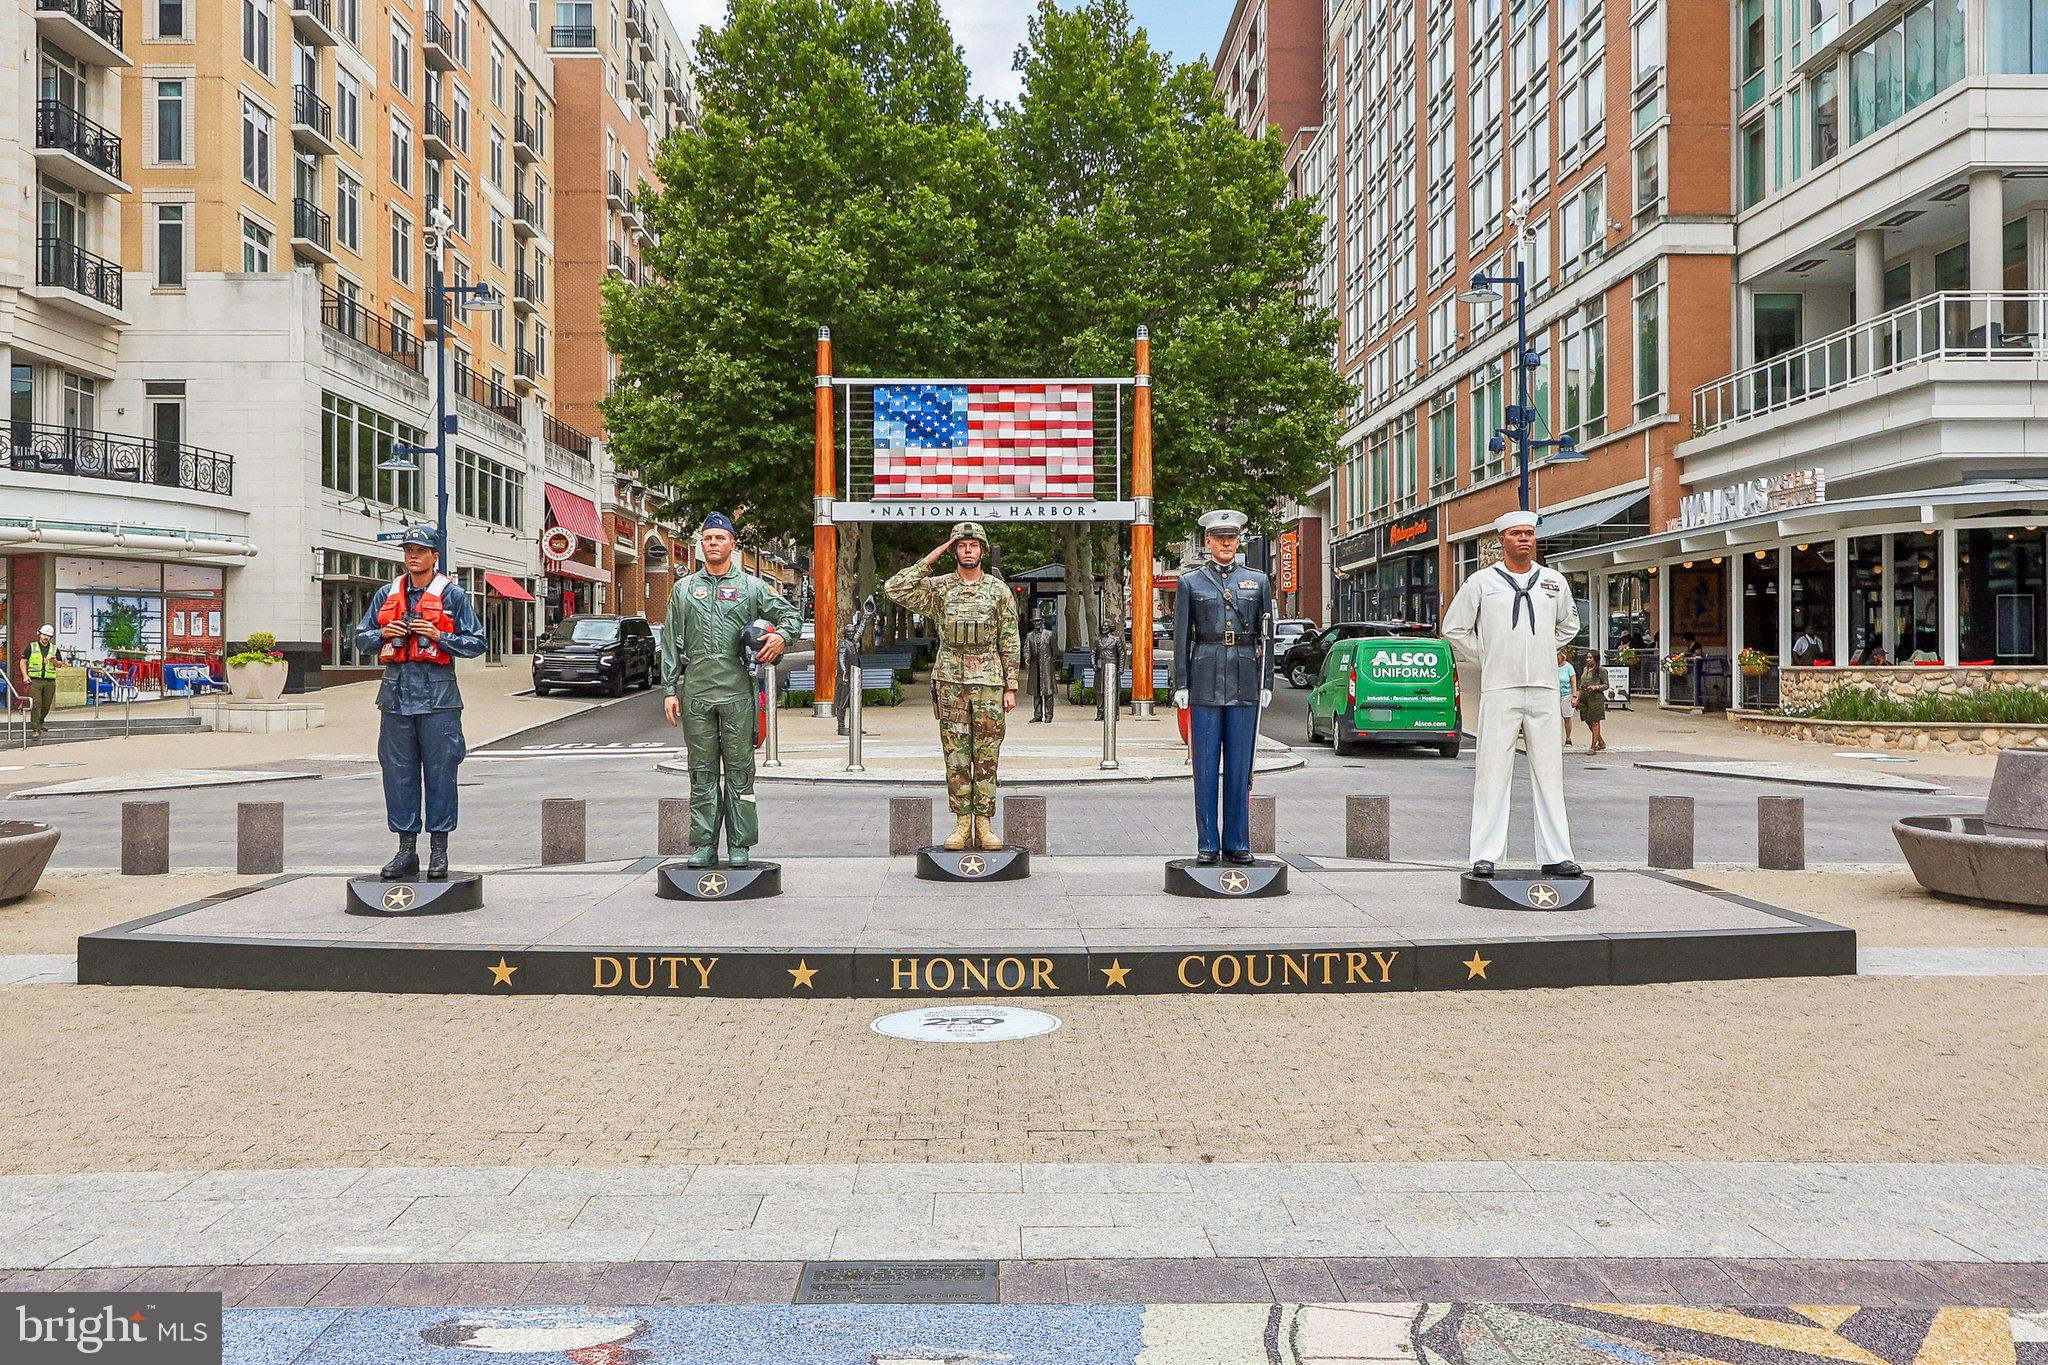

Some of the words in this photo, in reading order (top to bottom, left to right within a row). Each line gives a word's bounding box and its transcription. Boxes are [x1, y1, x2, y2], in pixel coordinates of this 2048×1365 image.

[881, 506, 979, 517] NATIONAL
[1010, 506, 1086, 517] HARBOR
[1283, 538, 1292, 588] BOMBAY
[1370, 651, 1438, 666] ALSCO
[592, 956, 719, 989] DUTY
[891, 956, 1059, 992] HONOR
[1176, 951, 1400, 989] COUNTRY
